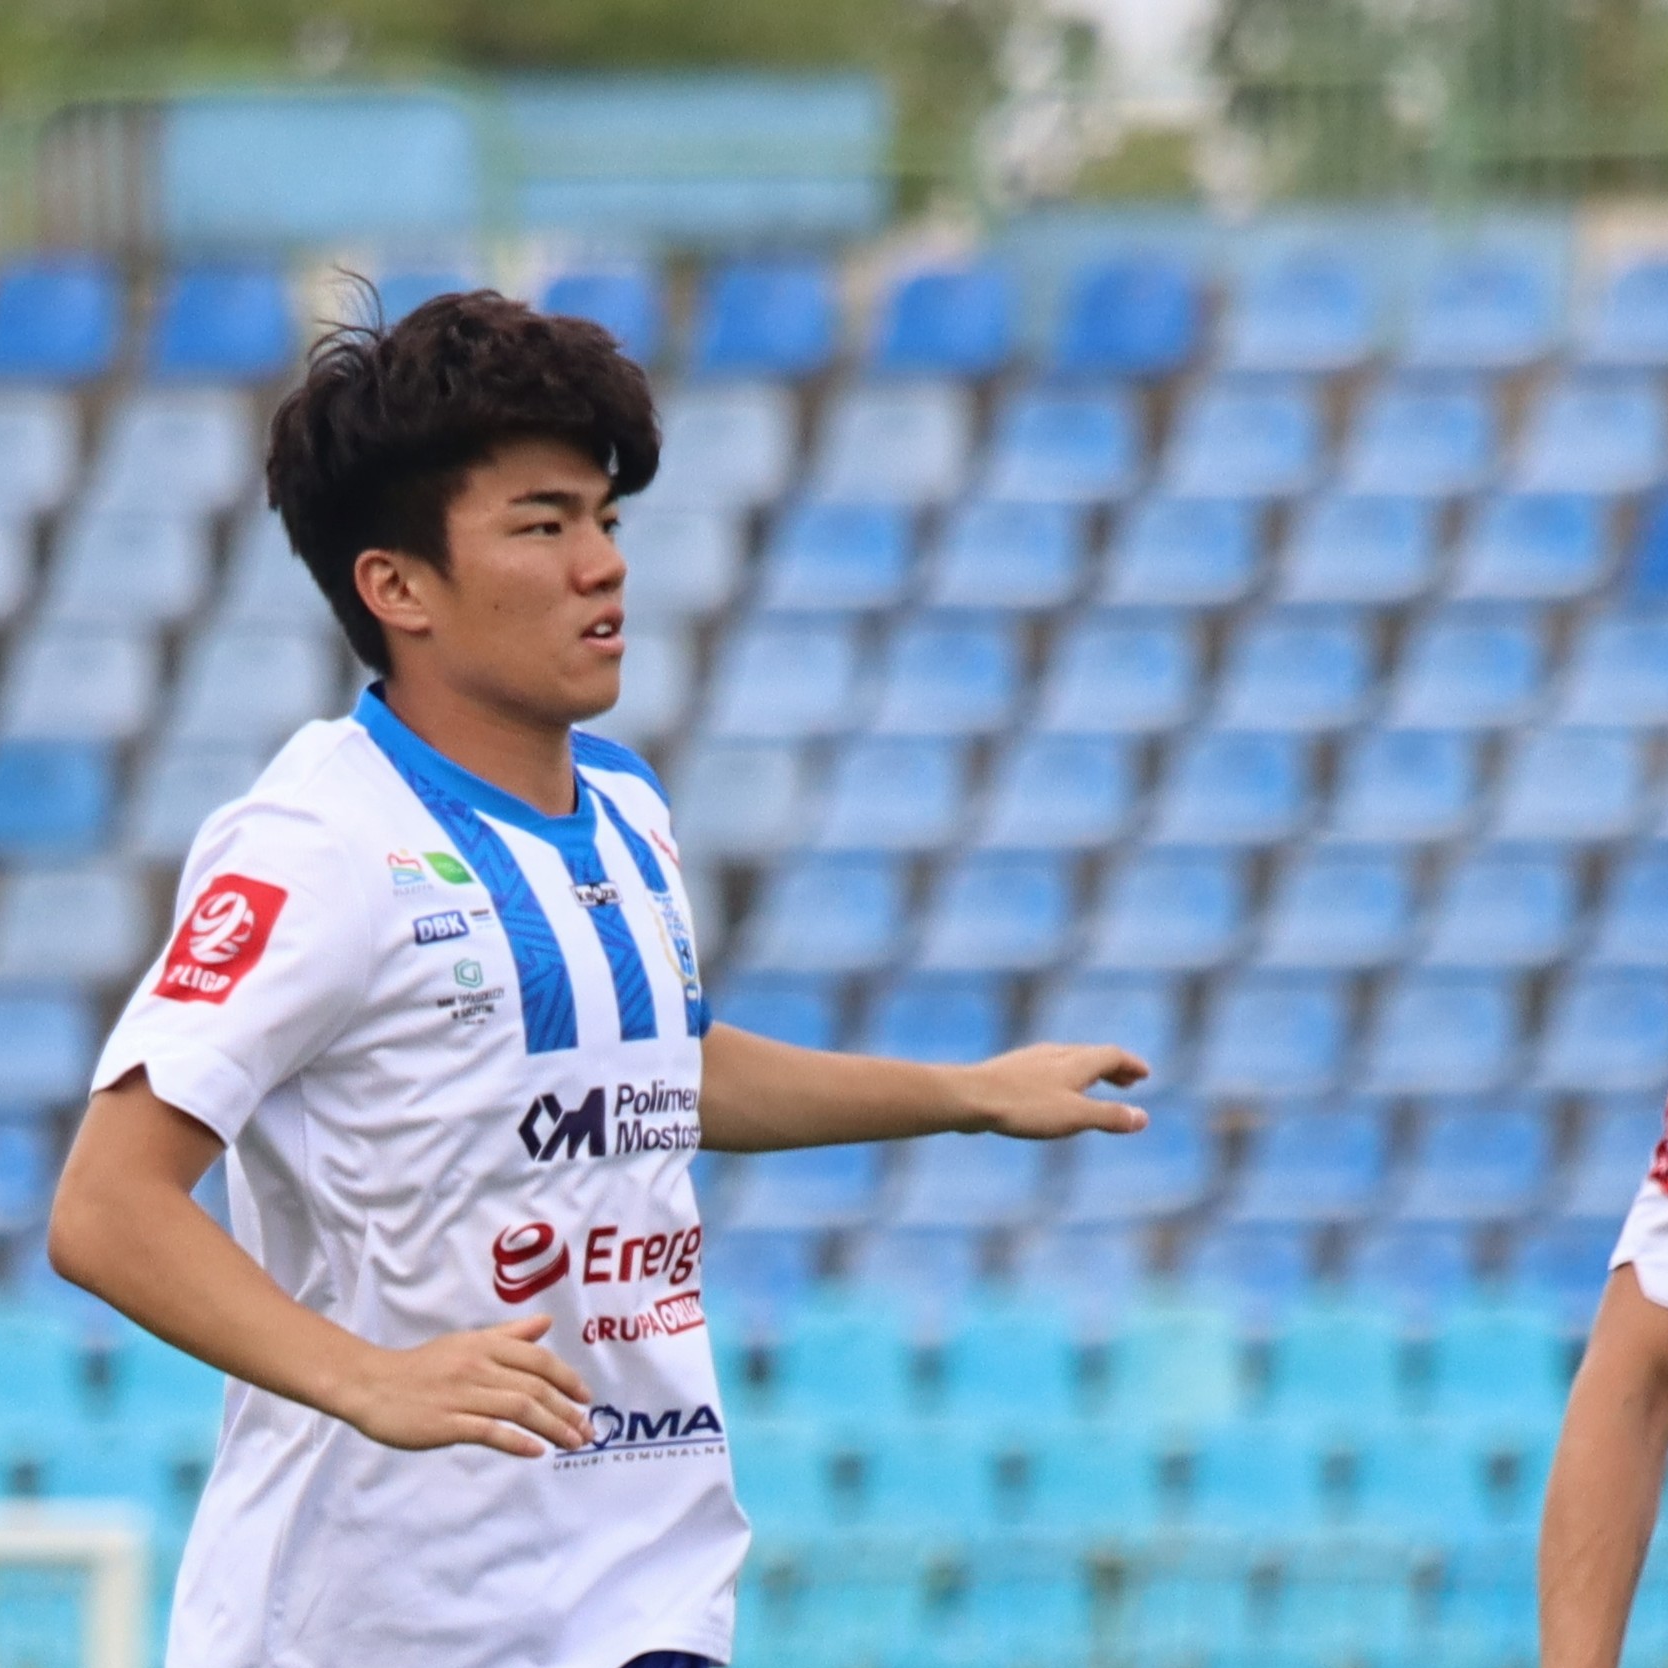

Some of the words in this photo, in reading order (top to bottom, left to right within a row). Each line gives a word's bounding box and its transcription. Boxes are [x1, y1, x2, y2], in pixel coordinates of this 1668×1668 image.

[416, 912, 466, 942] DBK
[583, 1225, 700, 1285] Energ
[583, 1312, 663, 1344] GRUPA
[589, 1404, 723, 1450] OMA
